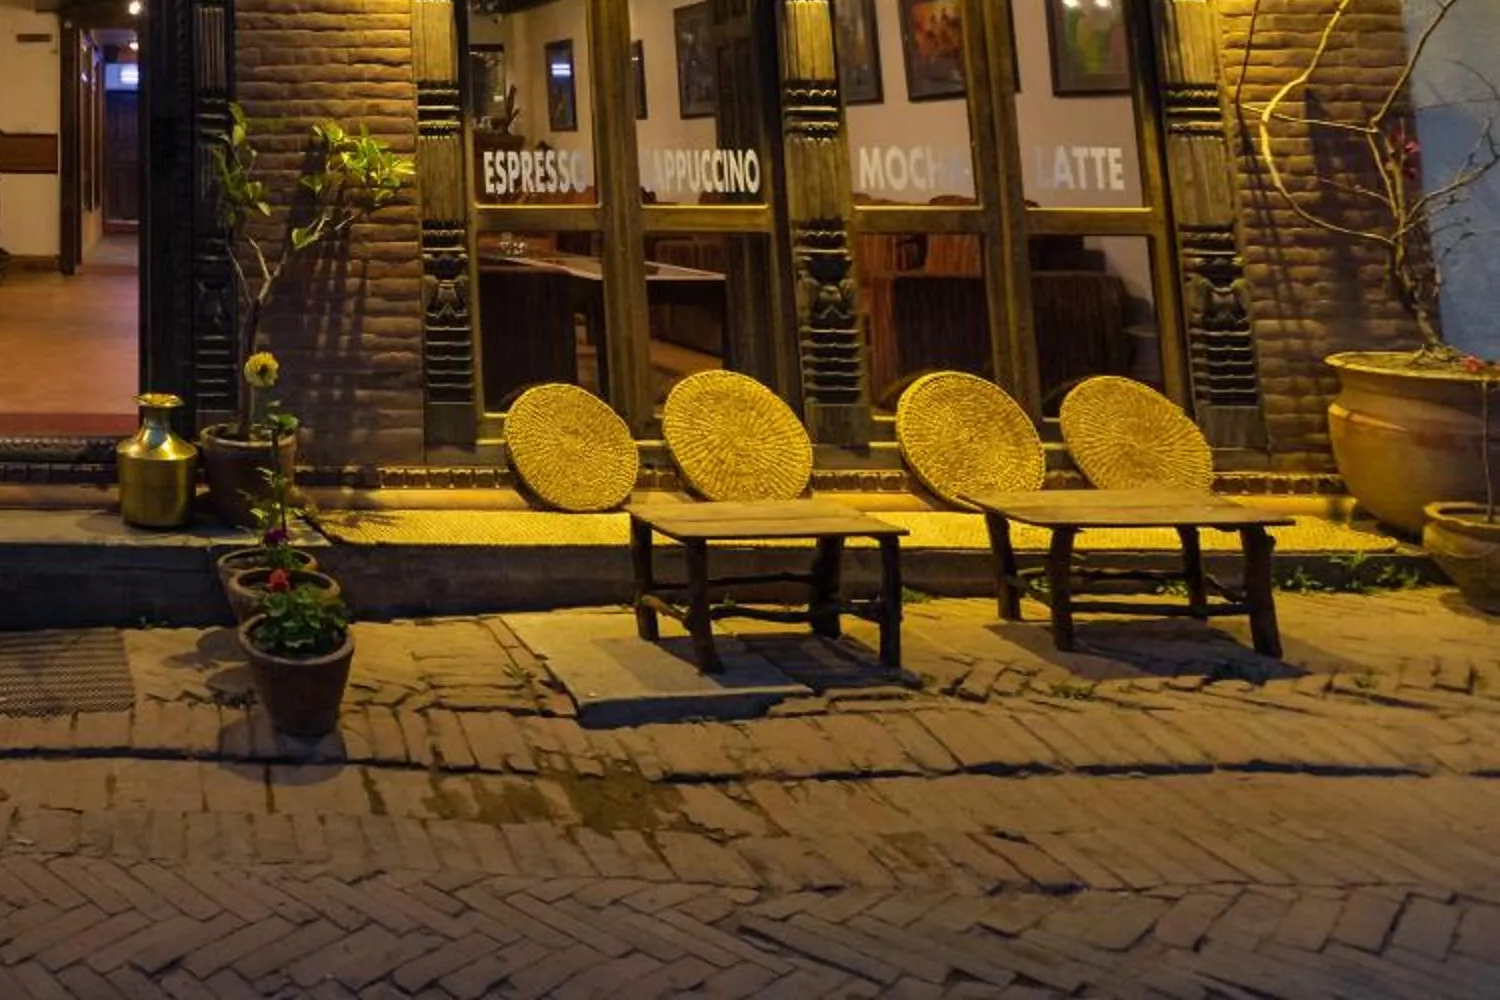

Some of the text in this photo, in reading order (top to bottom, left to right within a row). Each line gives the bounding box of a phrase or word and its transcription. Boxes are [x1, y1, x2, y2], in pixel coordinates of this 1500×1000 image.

[483, 150, 586, 195] ESPRESSO
[641, 148, 761, 194] APPUCCINO
[1033, 146, 1125, 191] LATTE
